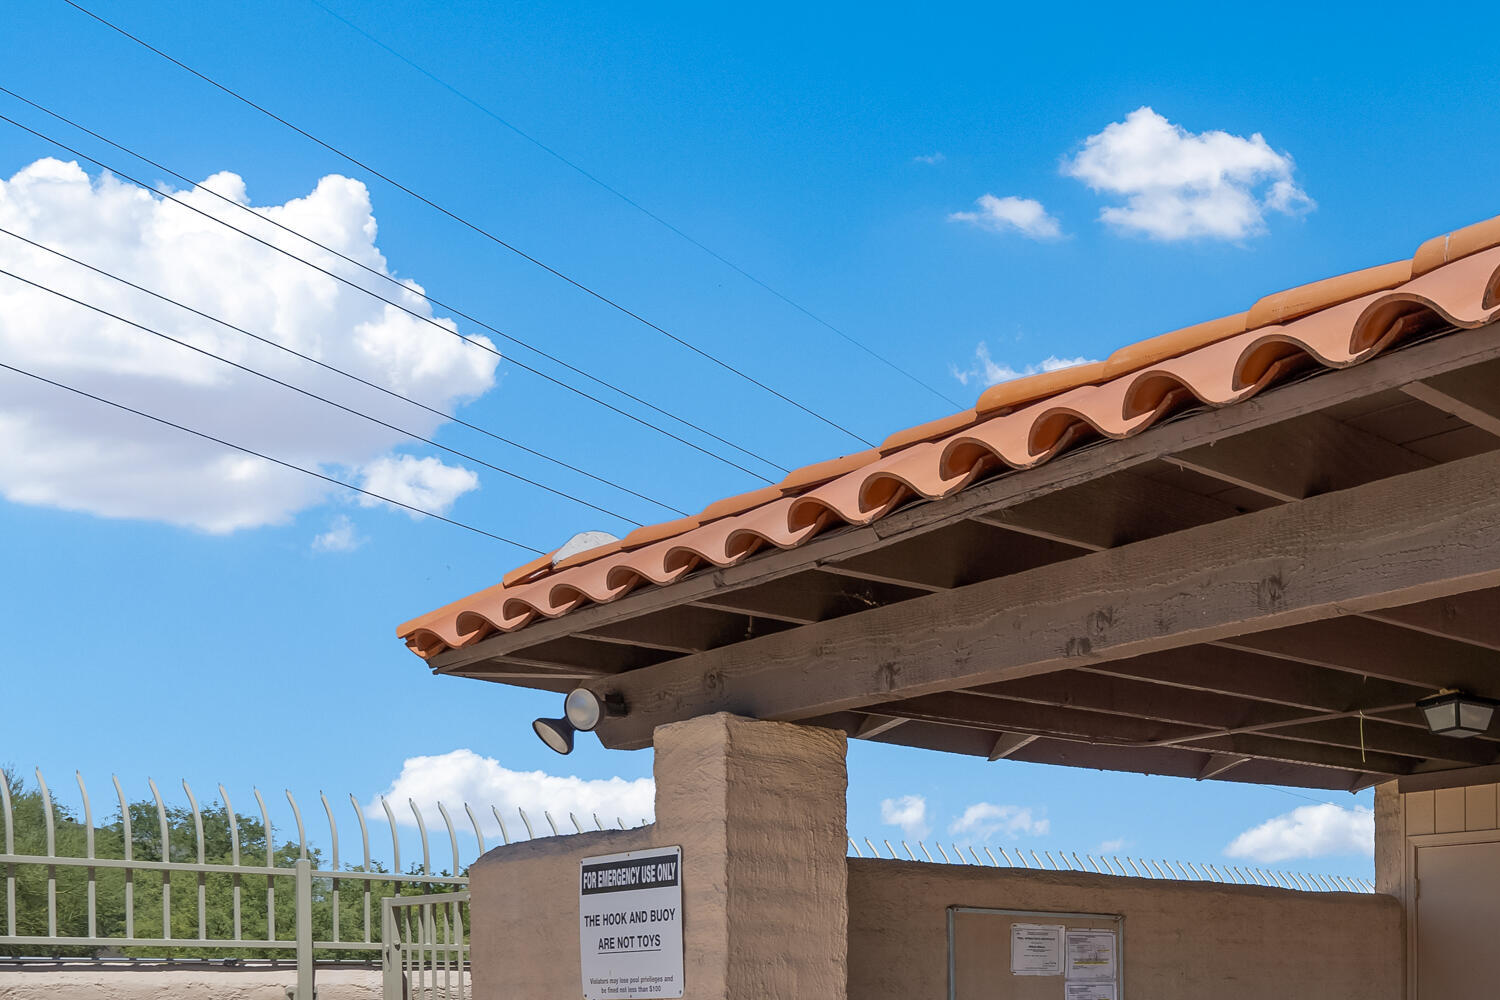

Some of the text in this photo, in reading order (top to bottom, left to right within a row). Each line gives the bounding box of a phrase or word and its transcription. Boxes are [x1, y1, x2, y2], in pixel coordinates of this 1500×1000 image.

[584, 862, 676, 889] FOR EMERGENCY USE ONLY
[584, 908, 675, 927] THE HOOK AND BUOY
[599, 934, 661, 950] ARE NOT TOYS
[641, 976, 663, 984] privileges
